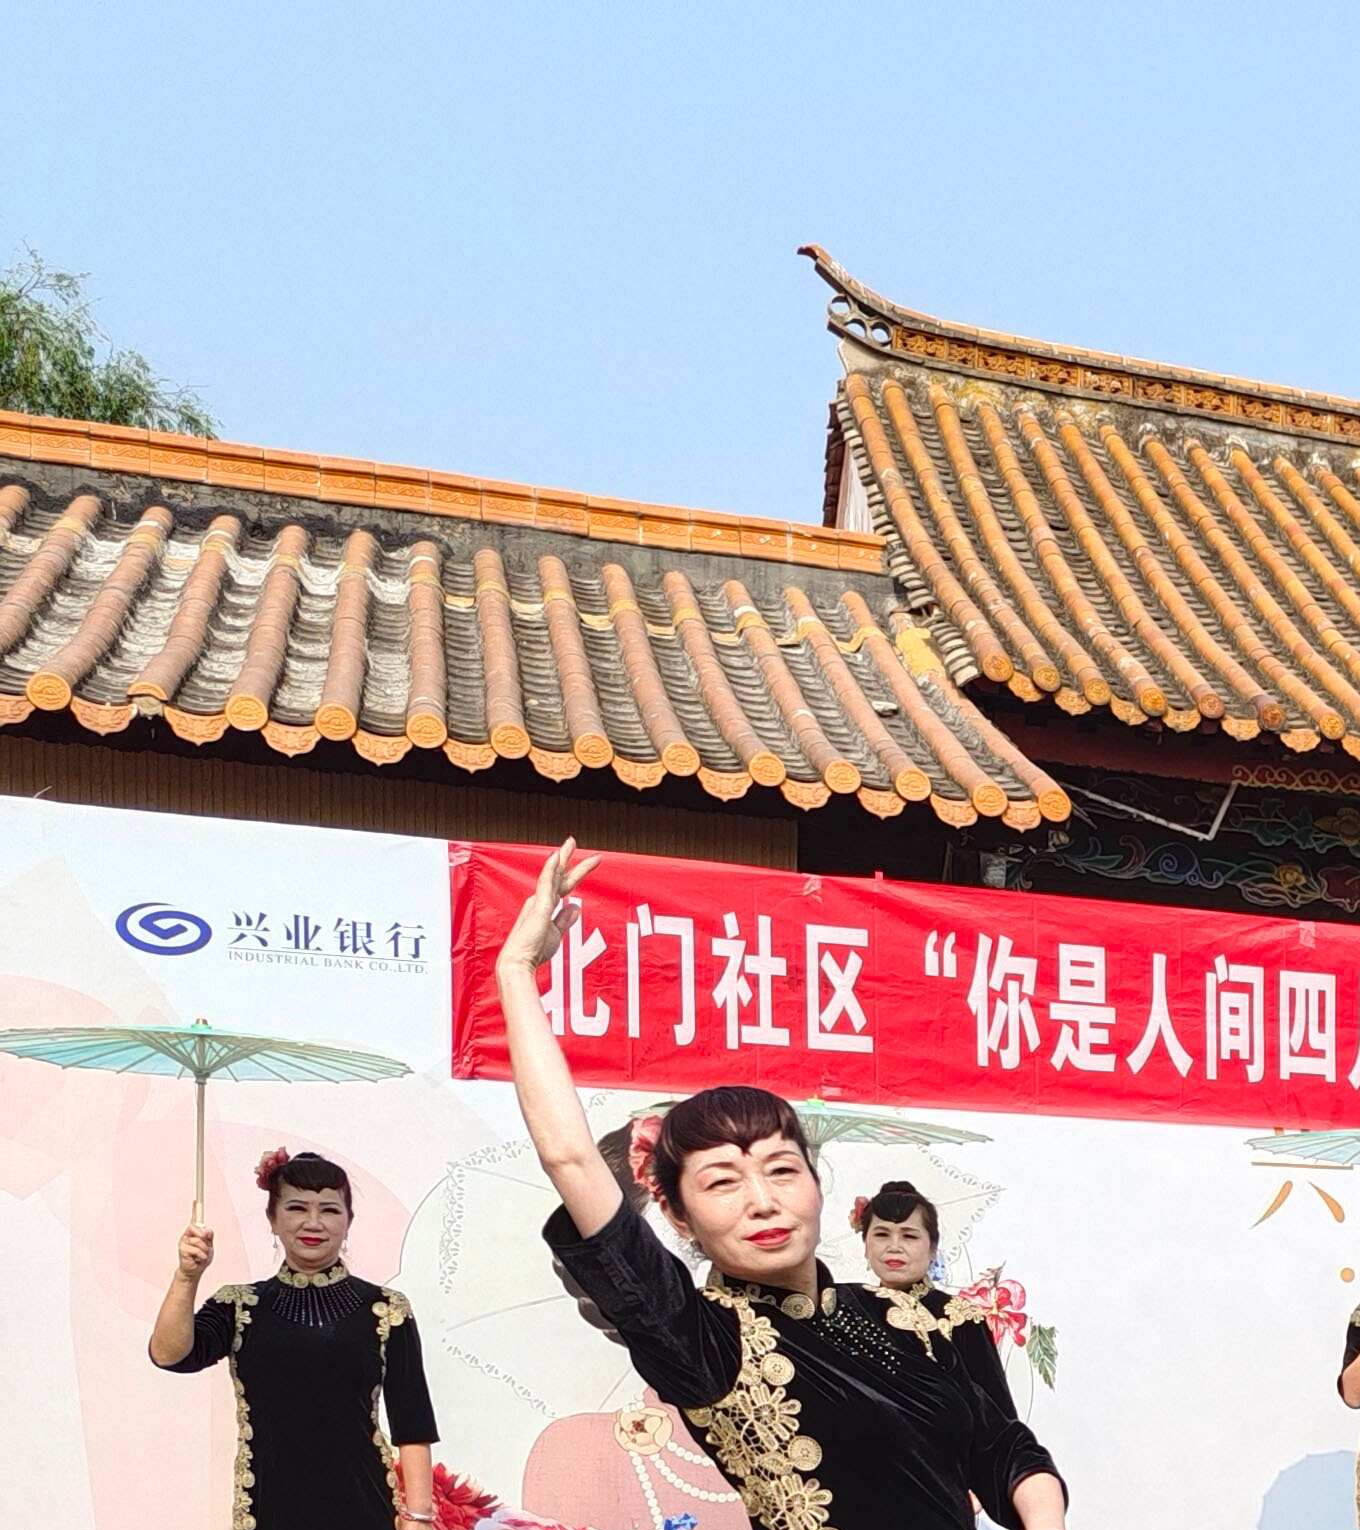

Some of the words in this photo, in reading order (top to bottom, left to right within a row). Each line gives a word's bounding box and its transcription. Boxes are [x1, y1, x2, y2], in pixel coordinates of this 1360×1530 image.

[227, 911, 427, 959] 兴业银行
[227, 950, 319, 968] INDUSTRIAL
[323, 958, 364, 970] BANK
[540, 897, 874, 1054] 北门社区
